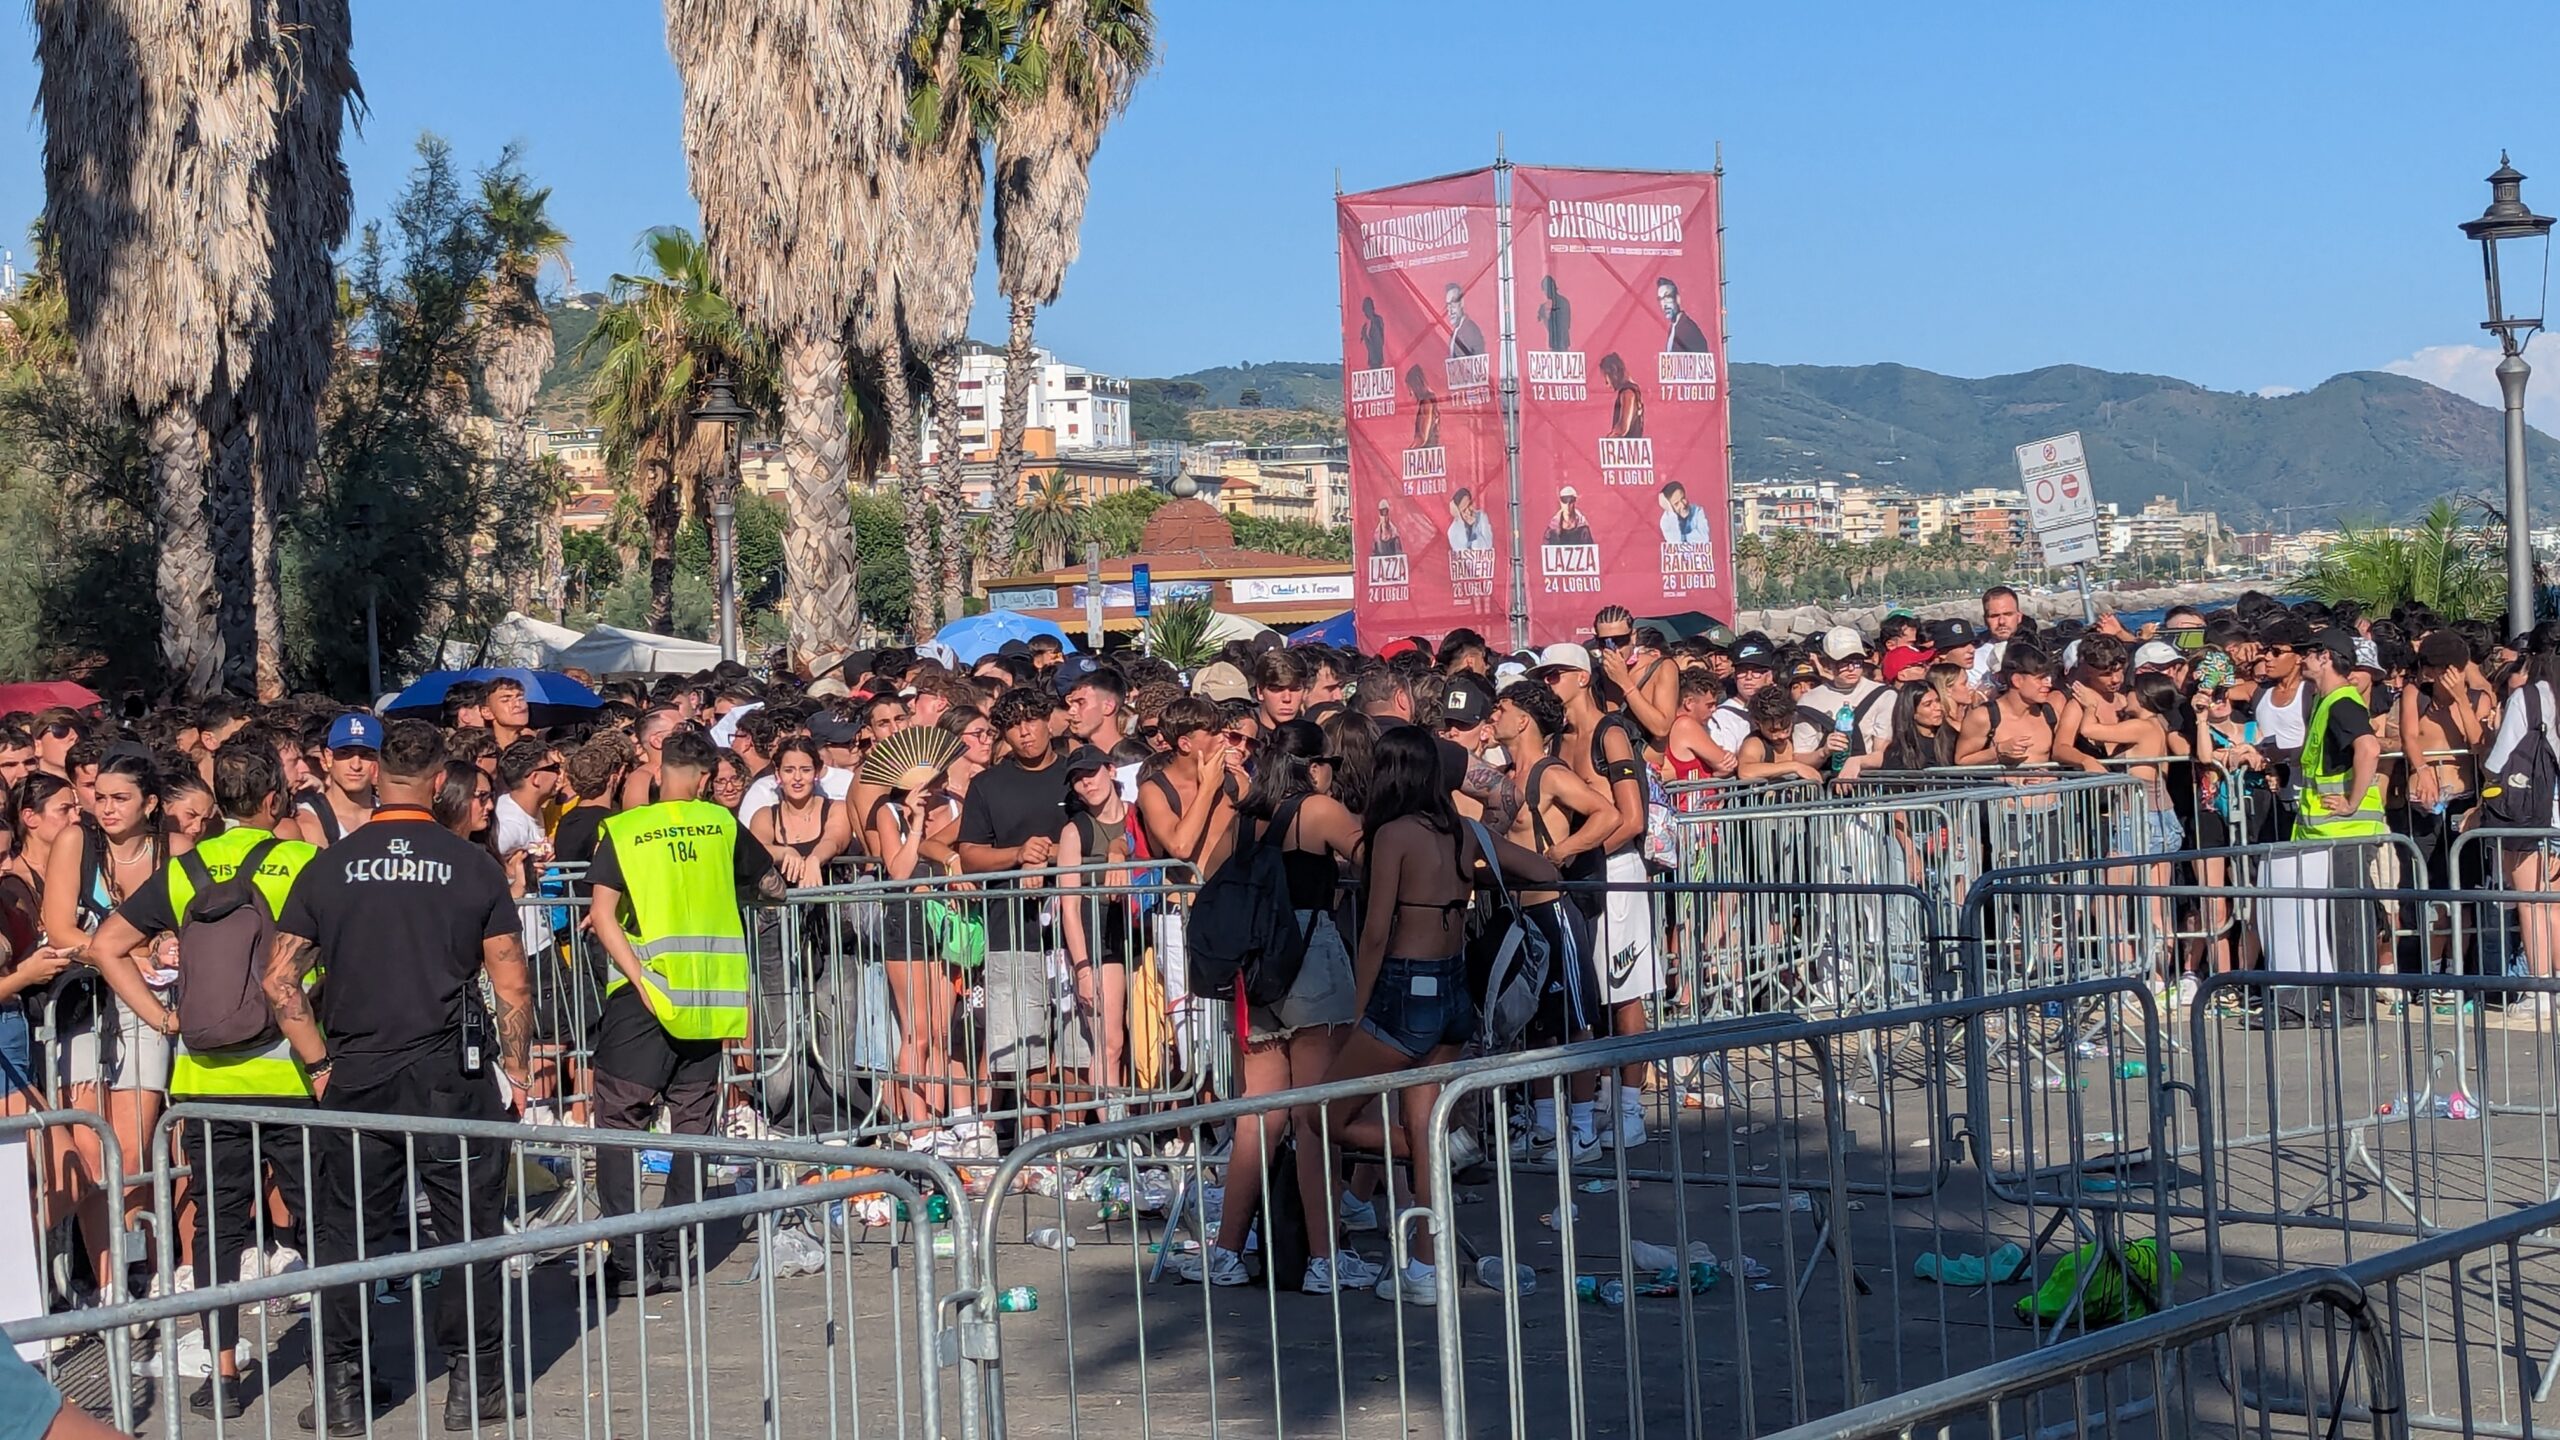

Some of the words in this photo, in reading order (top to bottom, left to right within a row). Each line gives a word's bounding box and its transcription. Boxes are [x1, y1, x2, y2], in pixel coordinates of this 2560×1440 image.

[1549, 200, 1683, 243] SALERNOSOUNDS
[1530, 354, 1553, 379] CAPO
[1555, 354, 1585, 380] PLAZA
[1698, 354, 1714, 380] SAS
[1532, 385, 1545, 401] 12
[1549, 385, 1587, 401] LUGLIO
[1661, 385, 1673, 401] 17
[1677, 385, 1716, 401] LUGLIO
[1353, 403, 1363, 419] 12
[1365, 401, 1396, 417] LUGLIO
[1602, 440, 1651, 466] IRAMA
[1603, 470, 1615, 486] 15
[1619, 469, 1654, 485] LUGLIO
[1545, 546, 1596, 572] LAZZA
[1663, 543, 1711, 555] MASSIMO
[1370, 556, 1407, 583] LAZZA
[1663, 554, 1713, 572] RANIERI
[1545, 577, 1559, 593] 24
[1562, 577, 1601, 592] LUGLIO
[1663, 574, 1677, 590] 26
[1680, 573, 1717, 590] LUGLIO
[1368, 587, 1379, 603] 24
[1381, 585, 1409, 602] LUGLIO
[350, 718, 365, 735] LA
[634, 824, 723, 846] ASSISTENZA
[667, 840, 698, 863] 184
[345, 858, 453, 885] SECURITY
[1612, 940, 1637, 974] NIKE
